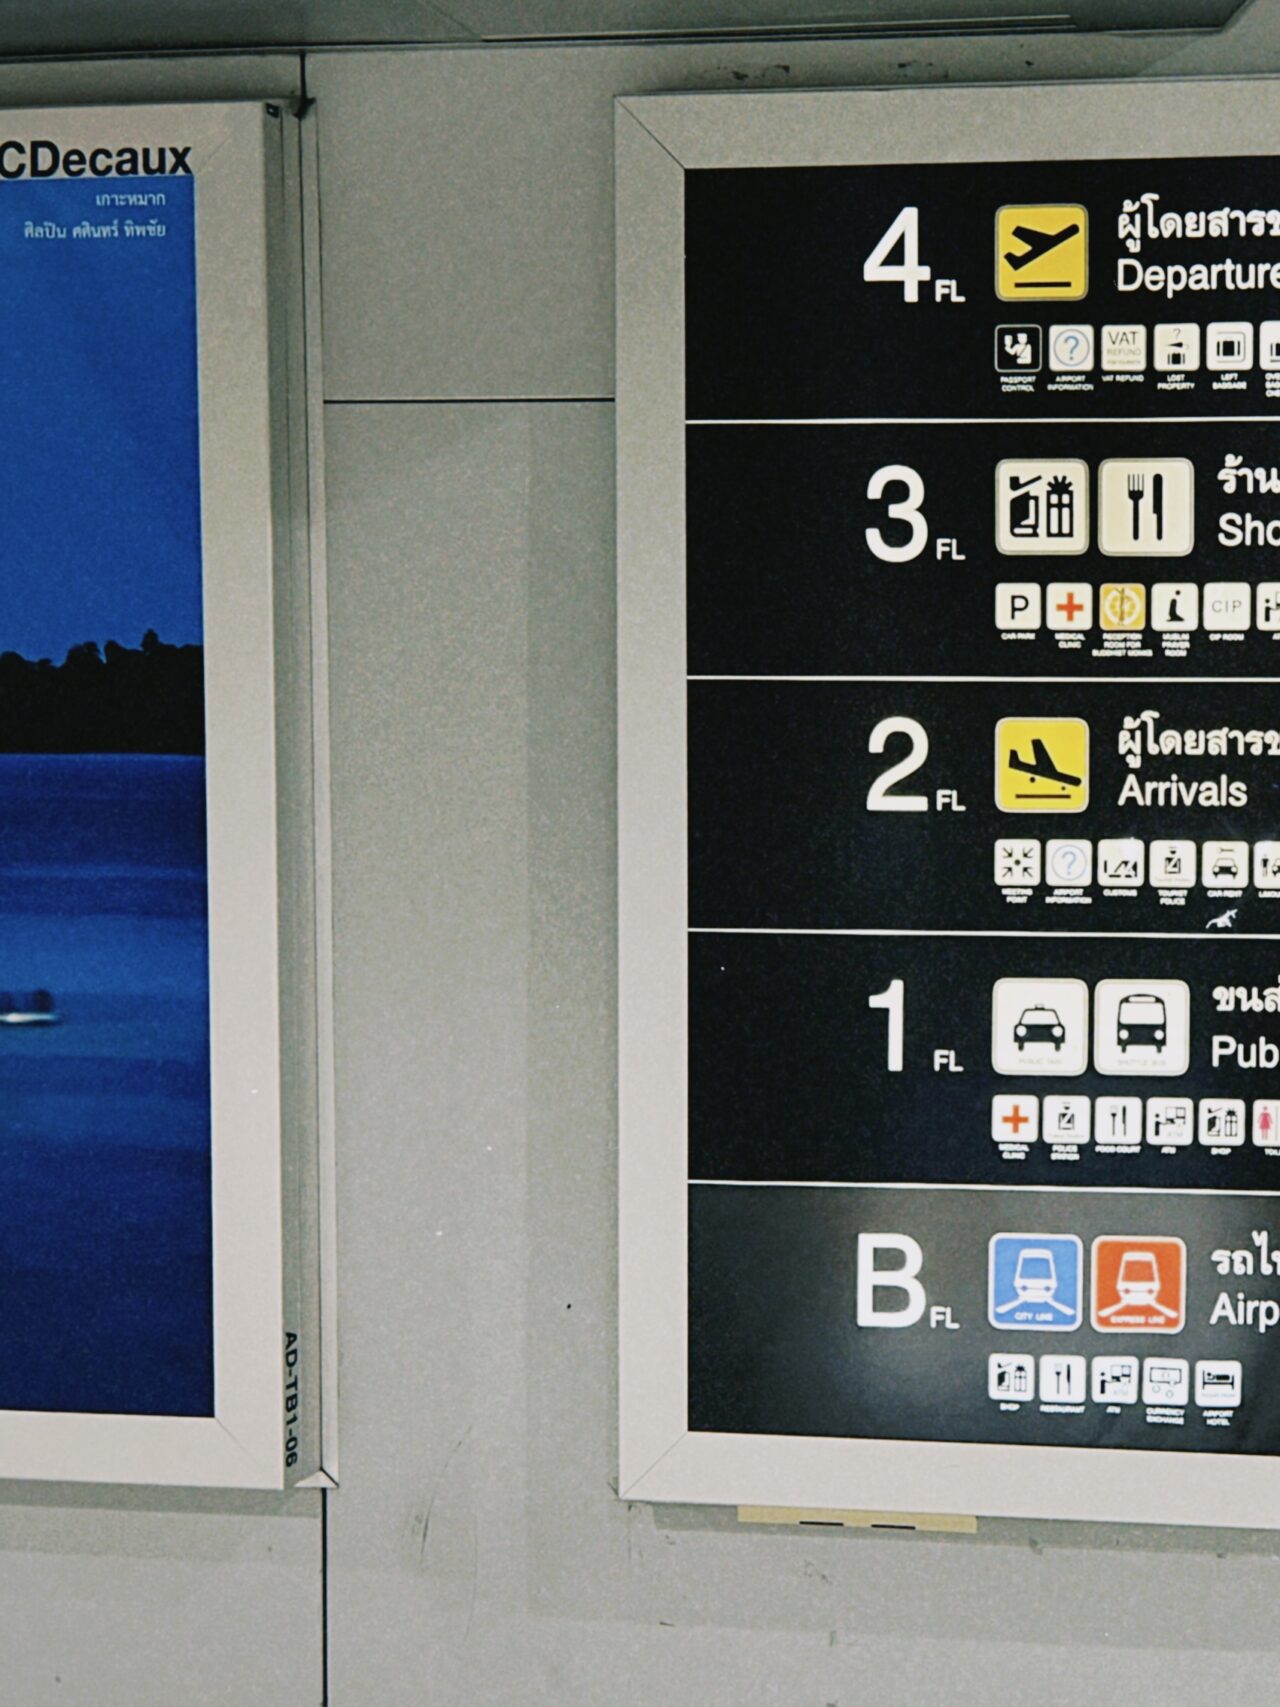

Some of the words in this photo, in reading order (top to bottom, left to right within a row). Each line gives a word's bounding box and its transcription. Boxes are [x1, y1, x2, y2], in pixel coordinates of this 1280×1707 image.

[96, 192, 166, 207] เกาะหมาก
[864, 207, 931, 302] 4
[935, 279, 965, 302] FL
[1108, 331, 1138, 345] VAT
[866, 465, 928, 562] 3
[937, 538, 965, 560] FL
[1011, 595, 1029, 620] P
[1212, 600, 1242, 613] CIP
[867, 716, 928, 811] 2
[936, 789, 966, 811] FL
[1118, 774, 1247, 807] Arrivals
[869, 979, 904, 1071] 1
[934, 1050, 963, 1072] FL
[857, 1233, 927, 1328] B
[930, 1306, 960, 1329] FL
[285, 1331, 298, 1467] AD-TB1-06
